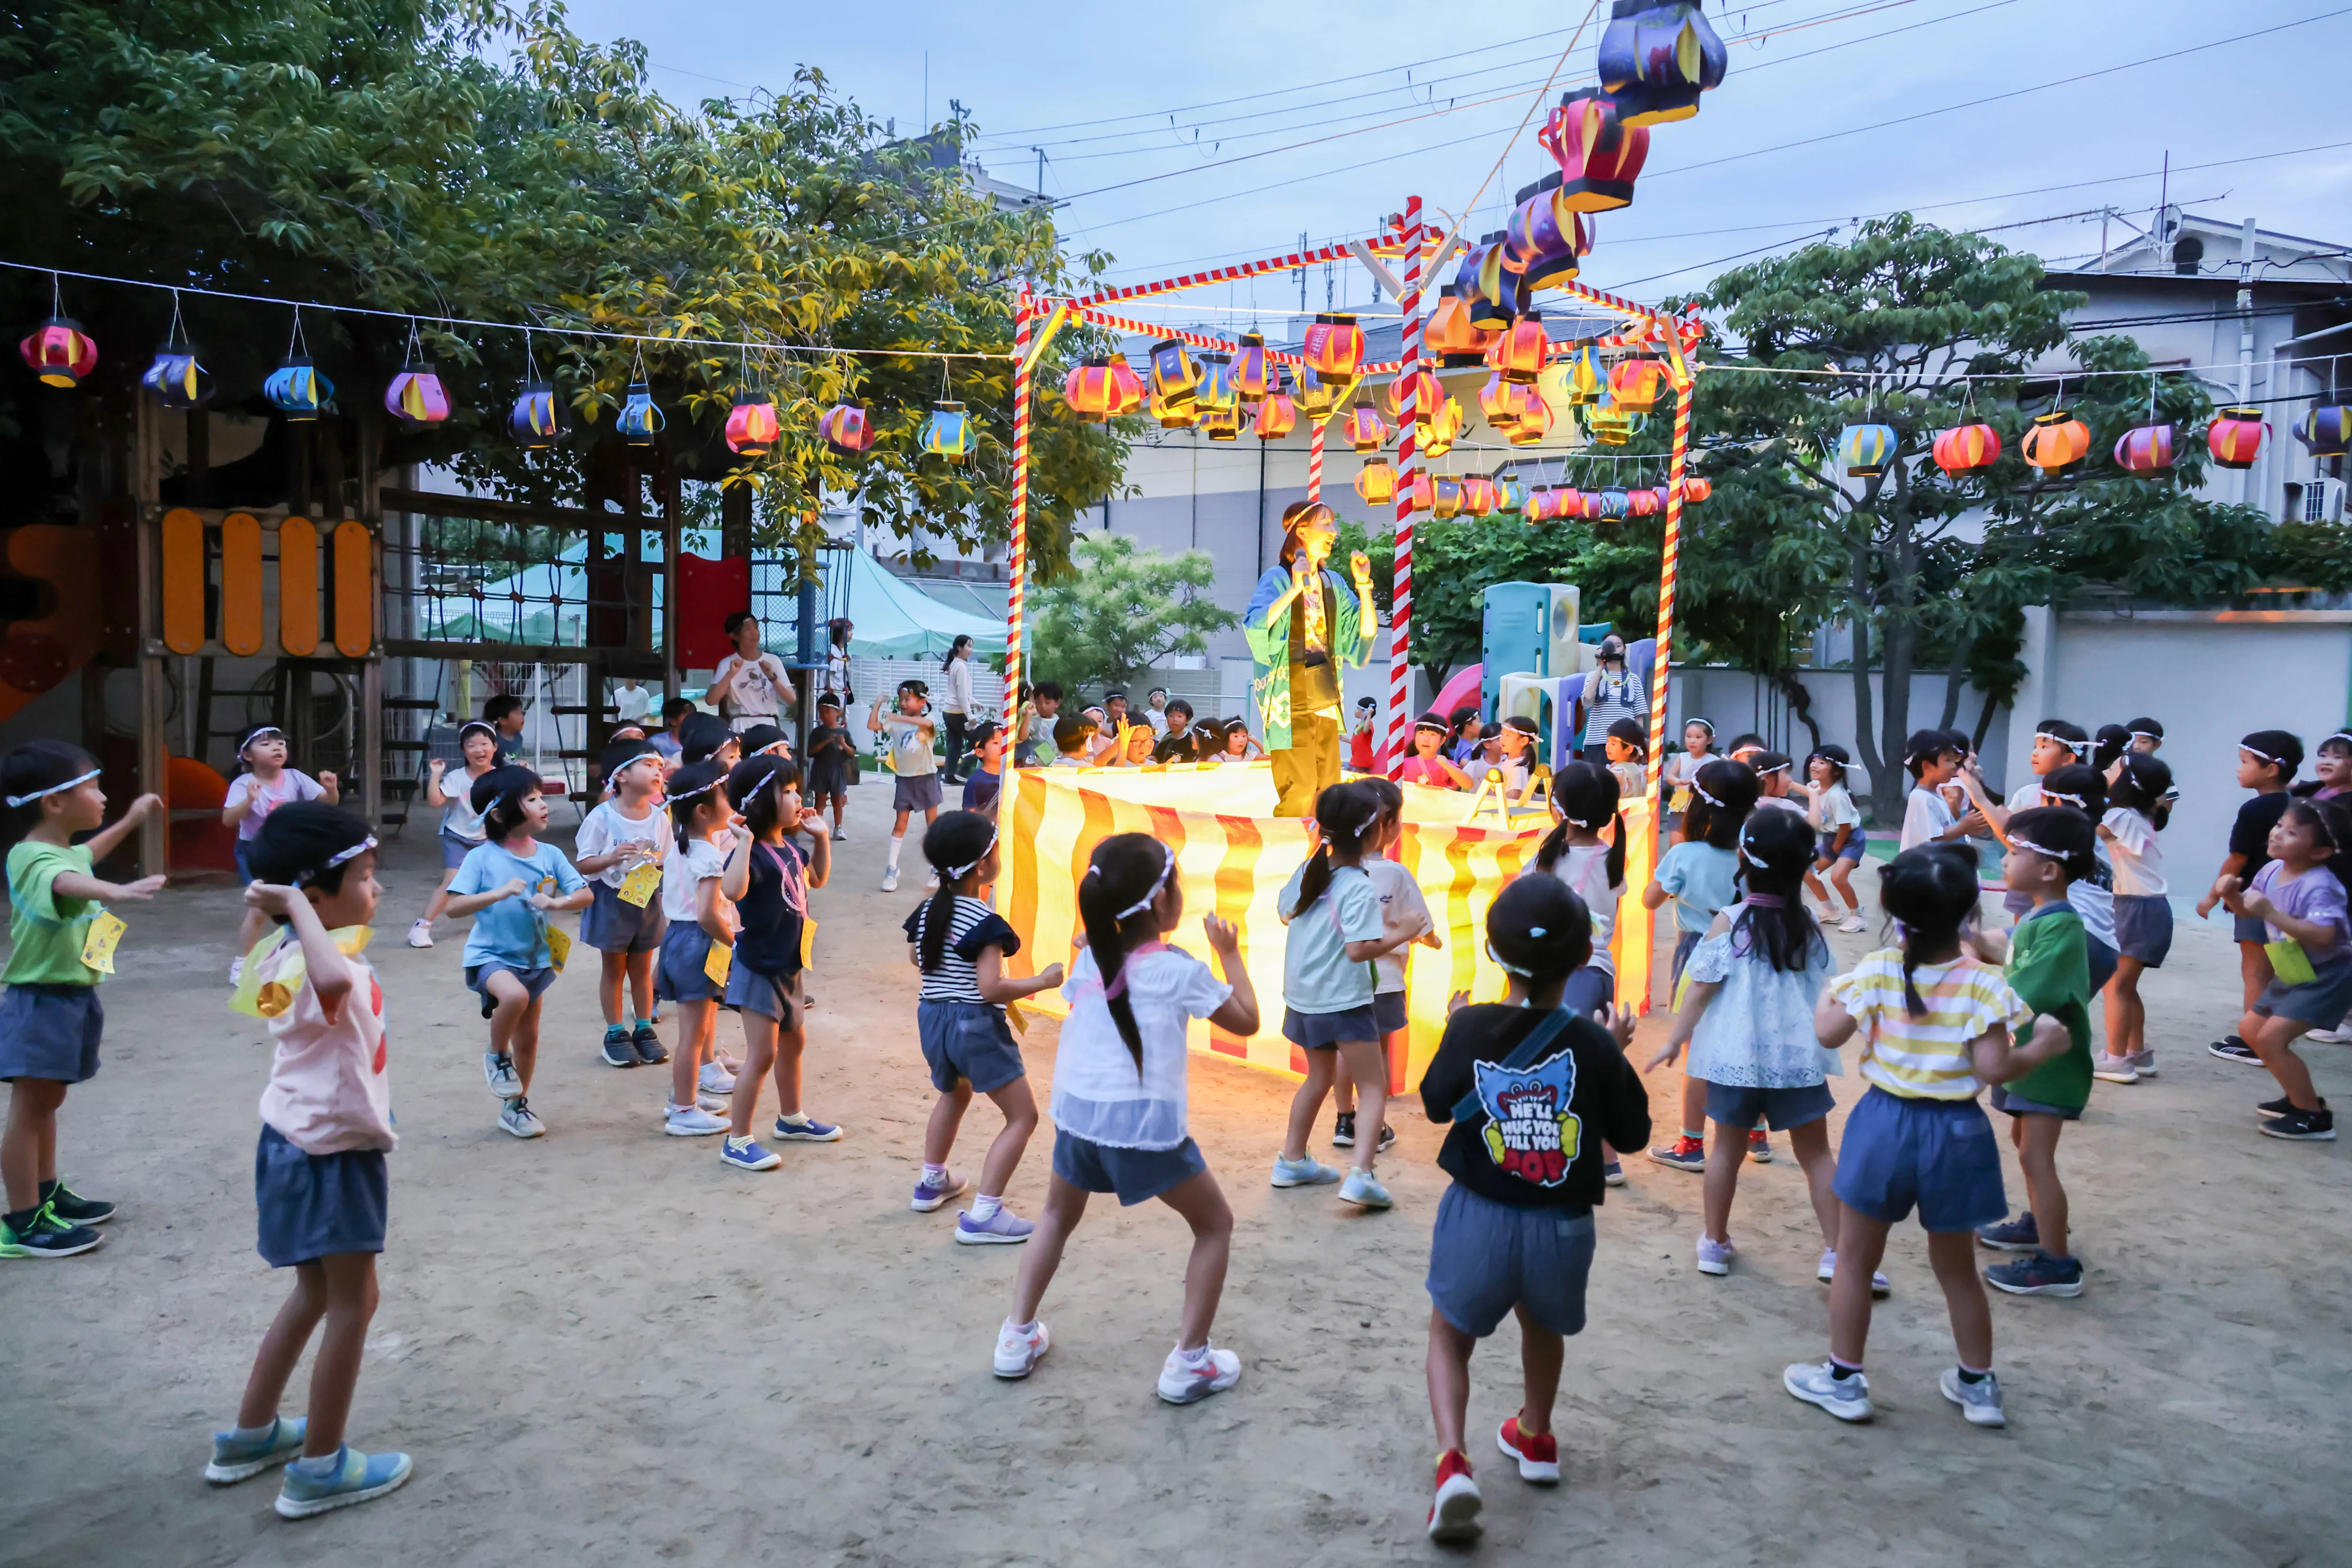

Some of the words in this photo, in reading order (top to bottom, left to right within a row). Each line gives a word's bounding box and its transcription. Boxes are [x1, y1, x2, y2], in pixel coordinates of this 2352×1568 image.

[1510, 1102, 1553, 1119] HE'LL
[1501, 1119, 1533, 1135] HUG
[1532, 1119, 1561, 1136] YOU
[1503, 1135, 1531, 1150] TILL
[1532, 1135, 1560, 1151] YOU
[1501, 1148, 1565, 1182] POP
